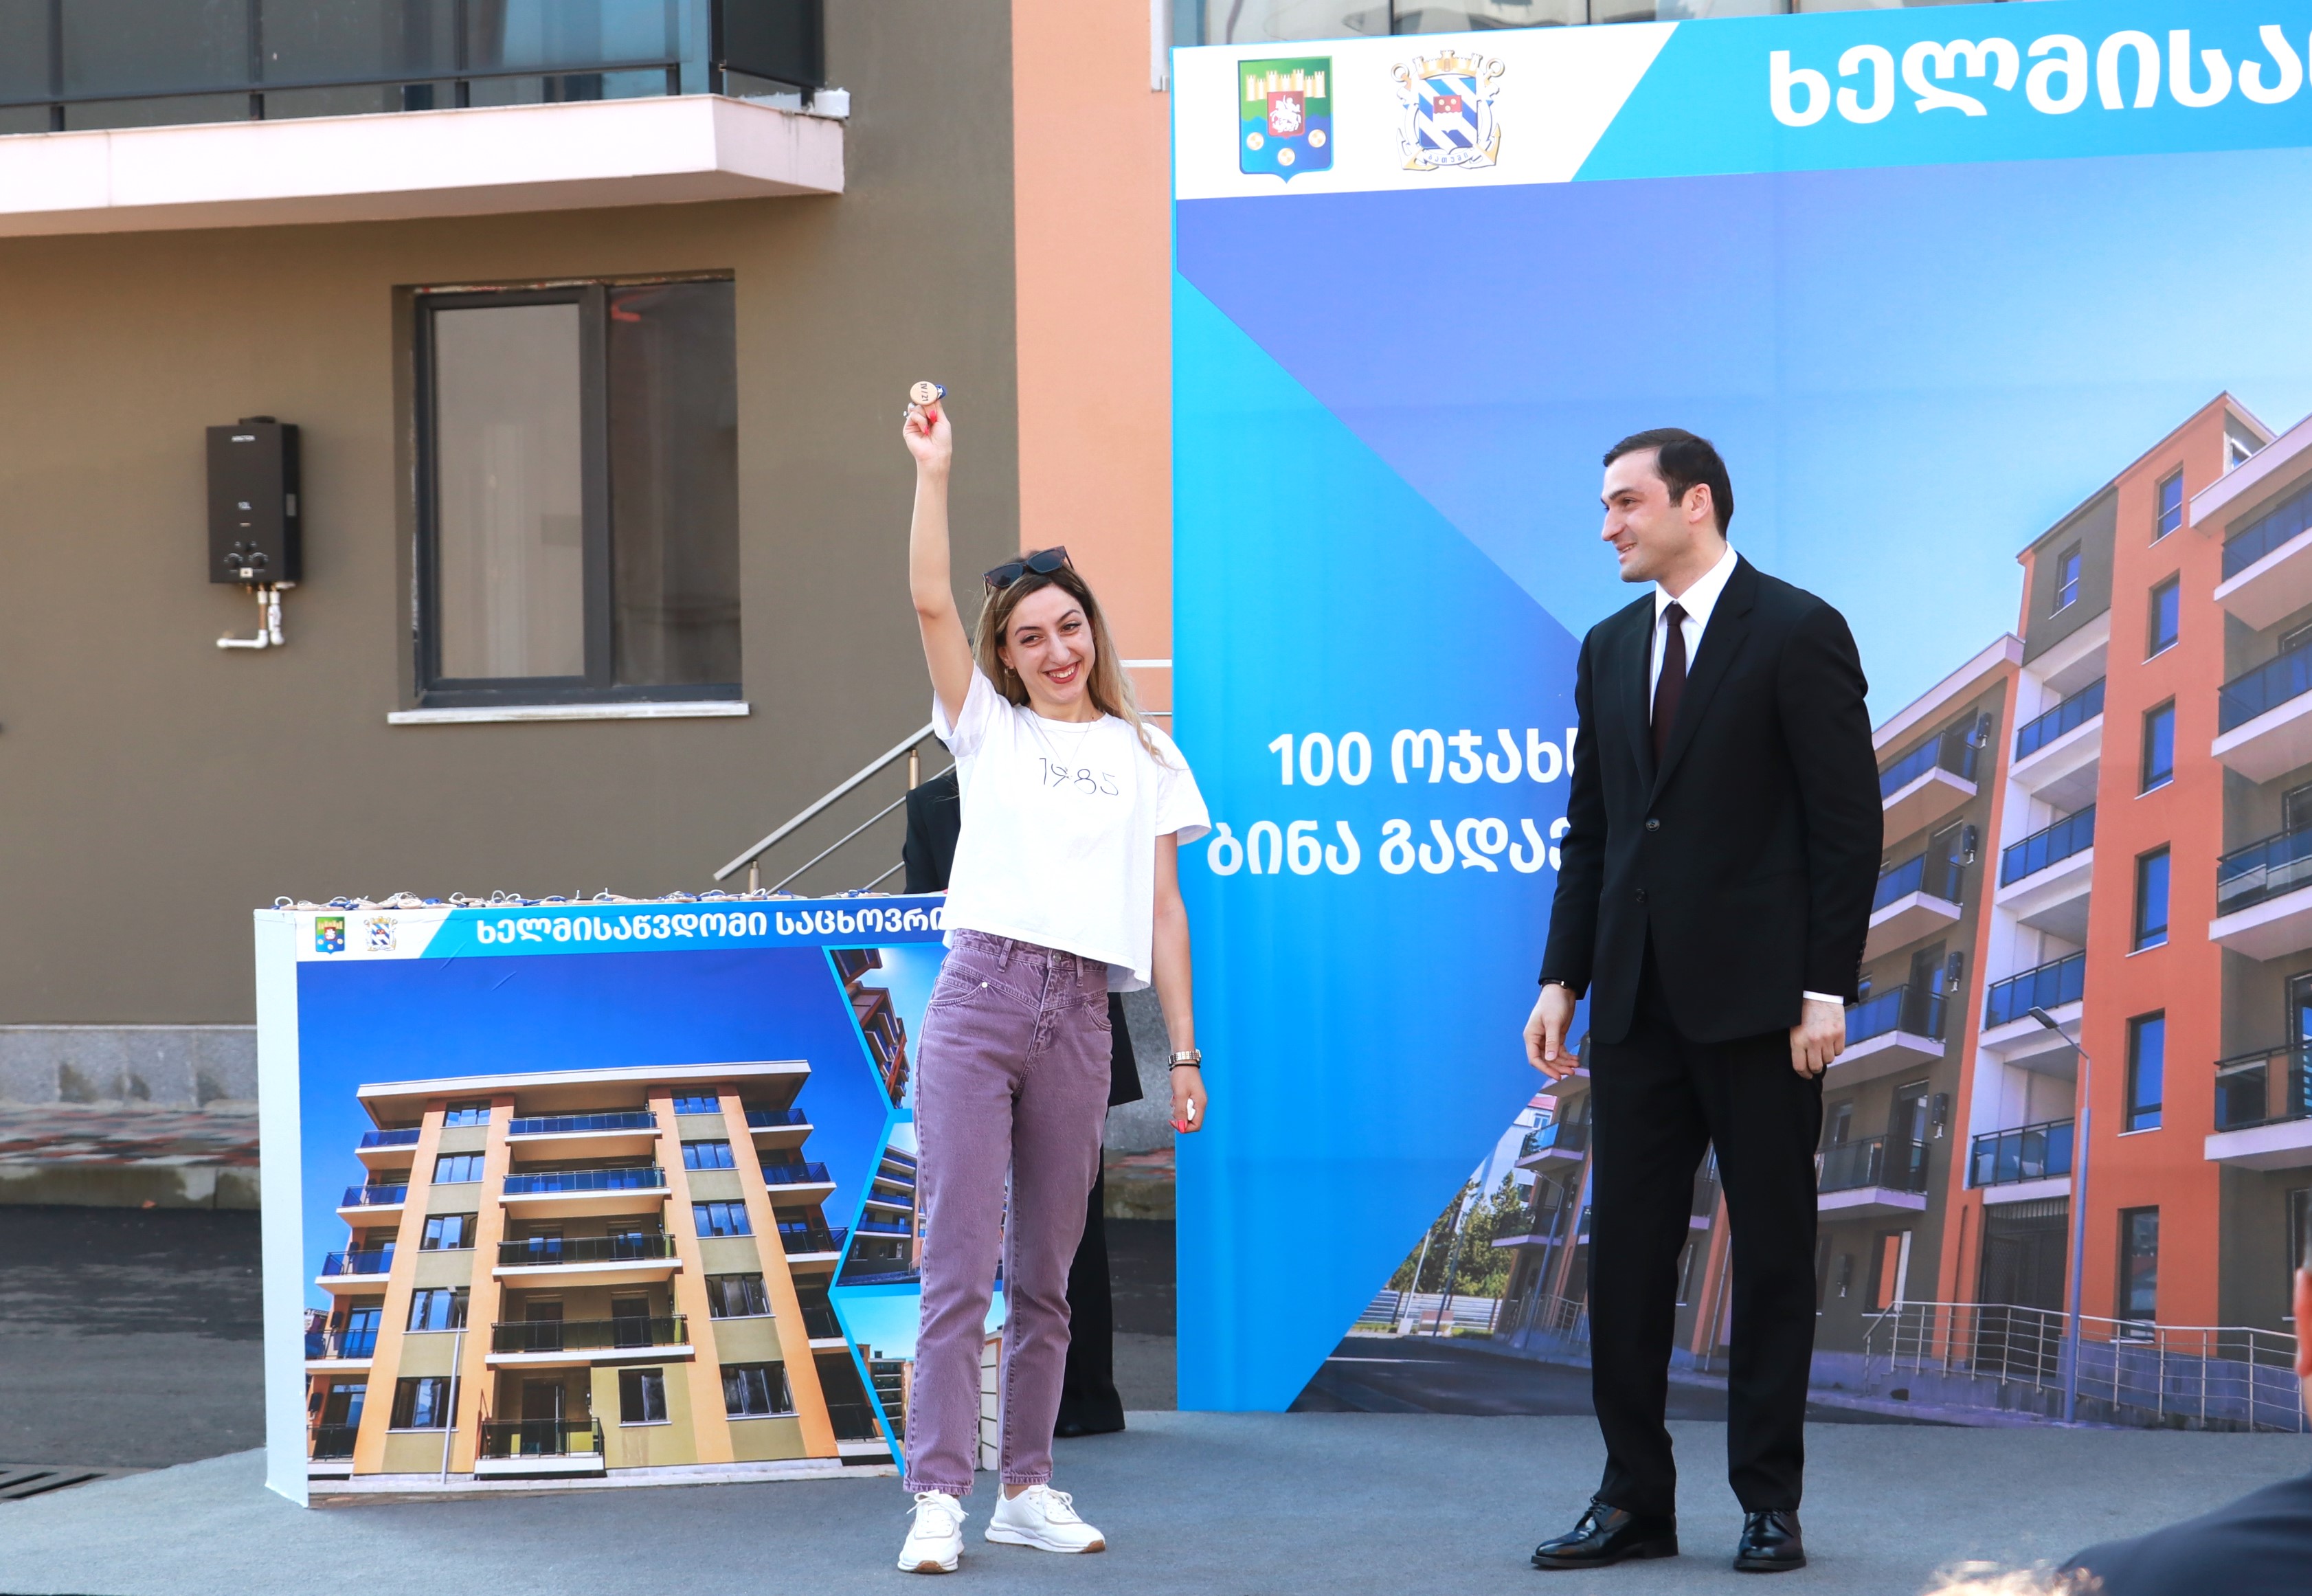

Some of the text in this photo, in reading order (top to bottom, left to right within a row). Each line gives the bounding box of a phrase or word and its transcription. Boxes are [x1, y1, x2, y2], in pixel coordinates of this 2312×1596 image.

[1770, 25, 2312, 126] ხელმისა
[1268, 732, 1372, 786] 100
[1207, 820, 1361, 876] ბინა
[477, 912, 767, 944] ხელმისაწვდომი
